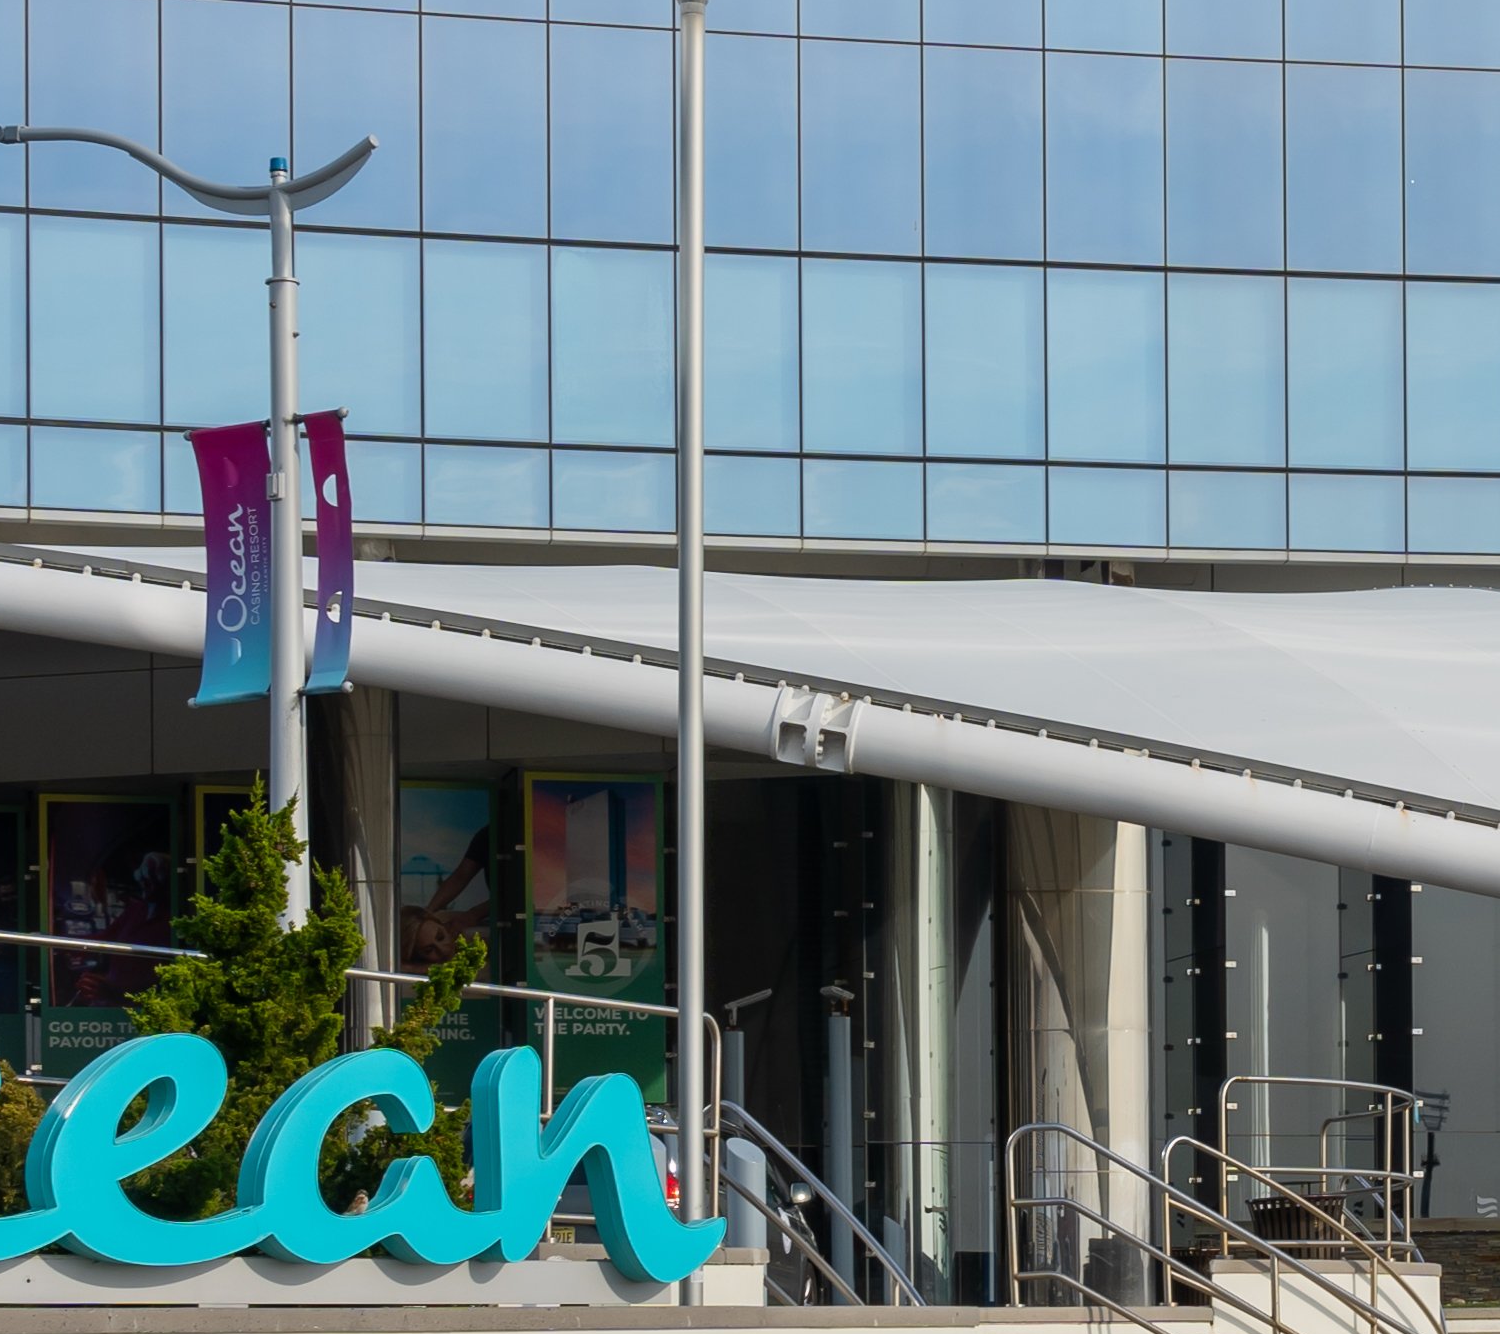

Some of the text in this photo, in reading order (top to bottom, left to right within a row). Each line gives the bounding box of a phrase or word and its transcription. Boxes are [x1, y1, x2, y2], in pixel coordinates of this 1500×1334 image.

[216, 503, 247, 632] Ocean
[246, 506, 261, 626] CASINO RESORT
[48, 1021, 74, 1033] GO
[78, 1021, 112, 1033] FOR
[572, 1023, 631, 1035] PARTY.
